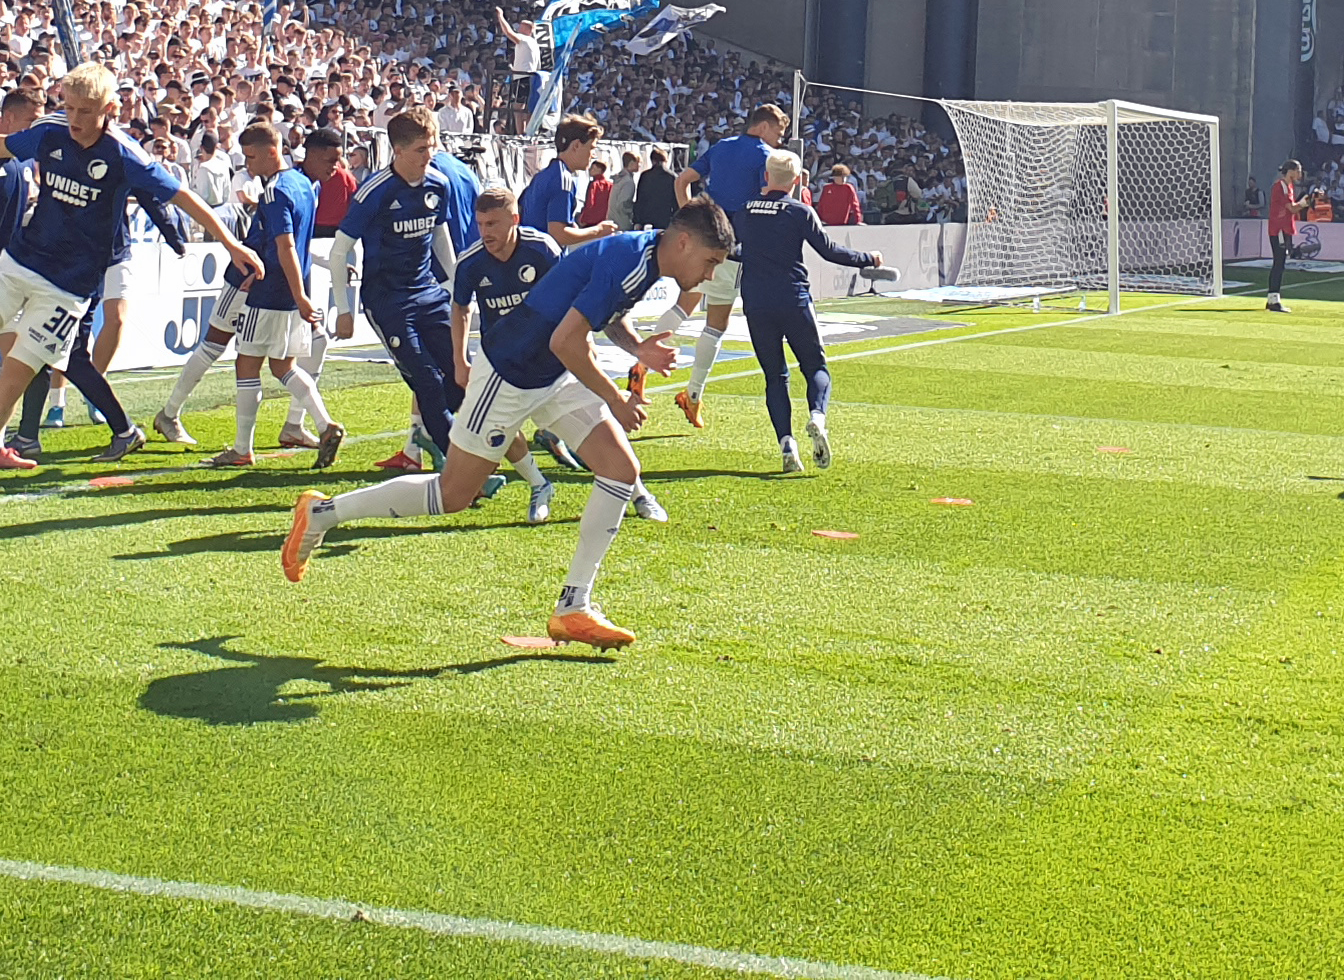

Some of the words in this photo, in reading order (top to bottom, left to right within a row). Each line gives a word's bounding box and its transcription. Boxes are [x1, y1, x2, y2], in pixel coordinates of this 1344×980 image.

[45, 171, 102, 201] UNIBET
[746, 200, 789, 210] UNIBET
[393, 215, 438, 233] UNIBET
[42, 305, 78, 341] 30
